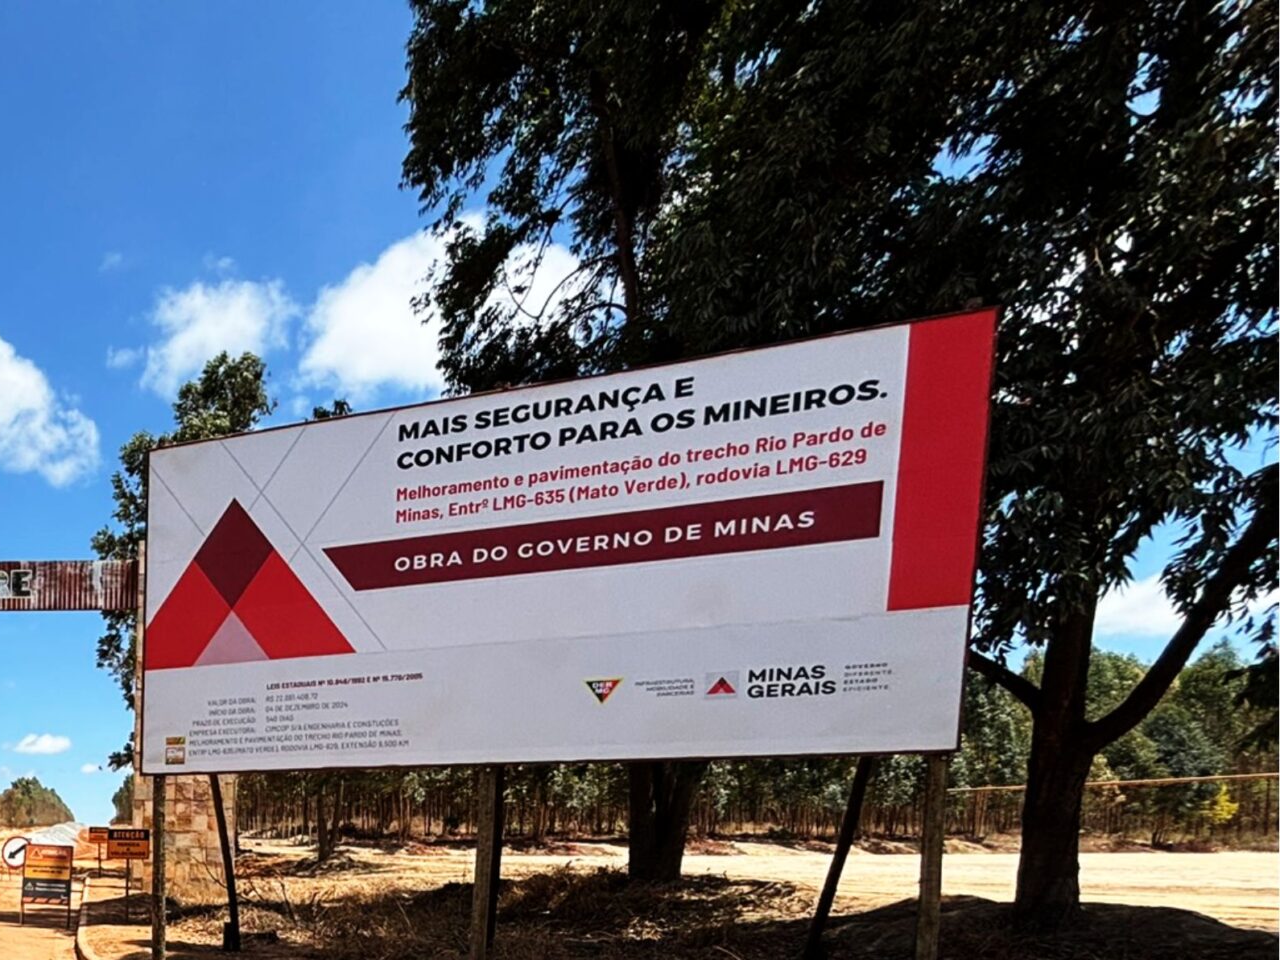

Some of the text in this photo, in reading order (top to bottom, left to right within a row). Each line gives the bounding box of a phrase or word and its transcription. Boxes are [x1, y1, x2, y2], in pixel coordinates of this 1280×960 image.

[398, 376, 695, 442] MAIS SEGURANÇA E
[396, 379, 888, 470] CONFORTO PARA OS MINEIROS.
[395, 421, 887, 502] Melhoramento e pavimentação do trecho Rio Pardo de
[395, 506, 444, 524] Minas,
[493, 488, 565, 512] LMG-635
[569, 482, 619, 503] (Mato
[624, 470, 691, 495] Verde),
[696, 462, 771, 486] rodovia
[776, 448, 868, 476] LMG-629
[394, 511, 816, 571] OBRA DO GOVERNO DE MINAS
[747, 664, 827, 683] MINAS
[281, 680, 317, 690] ESTADUAIS
[746, 680, 837, 699] GERAIS
[285, 702, 320, 711] DEZEMBRO
[303, 721, 346, 731] ENGENHARIA
[189, 736, 238, 746] MELHORAMENTO
[245, 732, 292, 743] PAVIMENTAÇÃO
[304, 732, 330, 740] TRECHO
[345, 730, 367, 739] PARDO
[113, 831, 145, 839] ATENÇÃO
